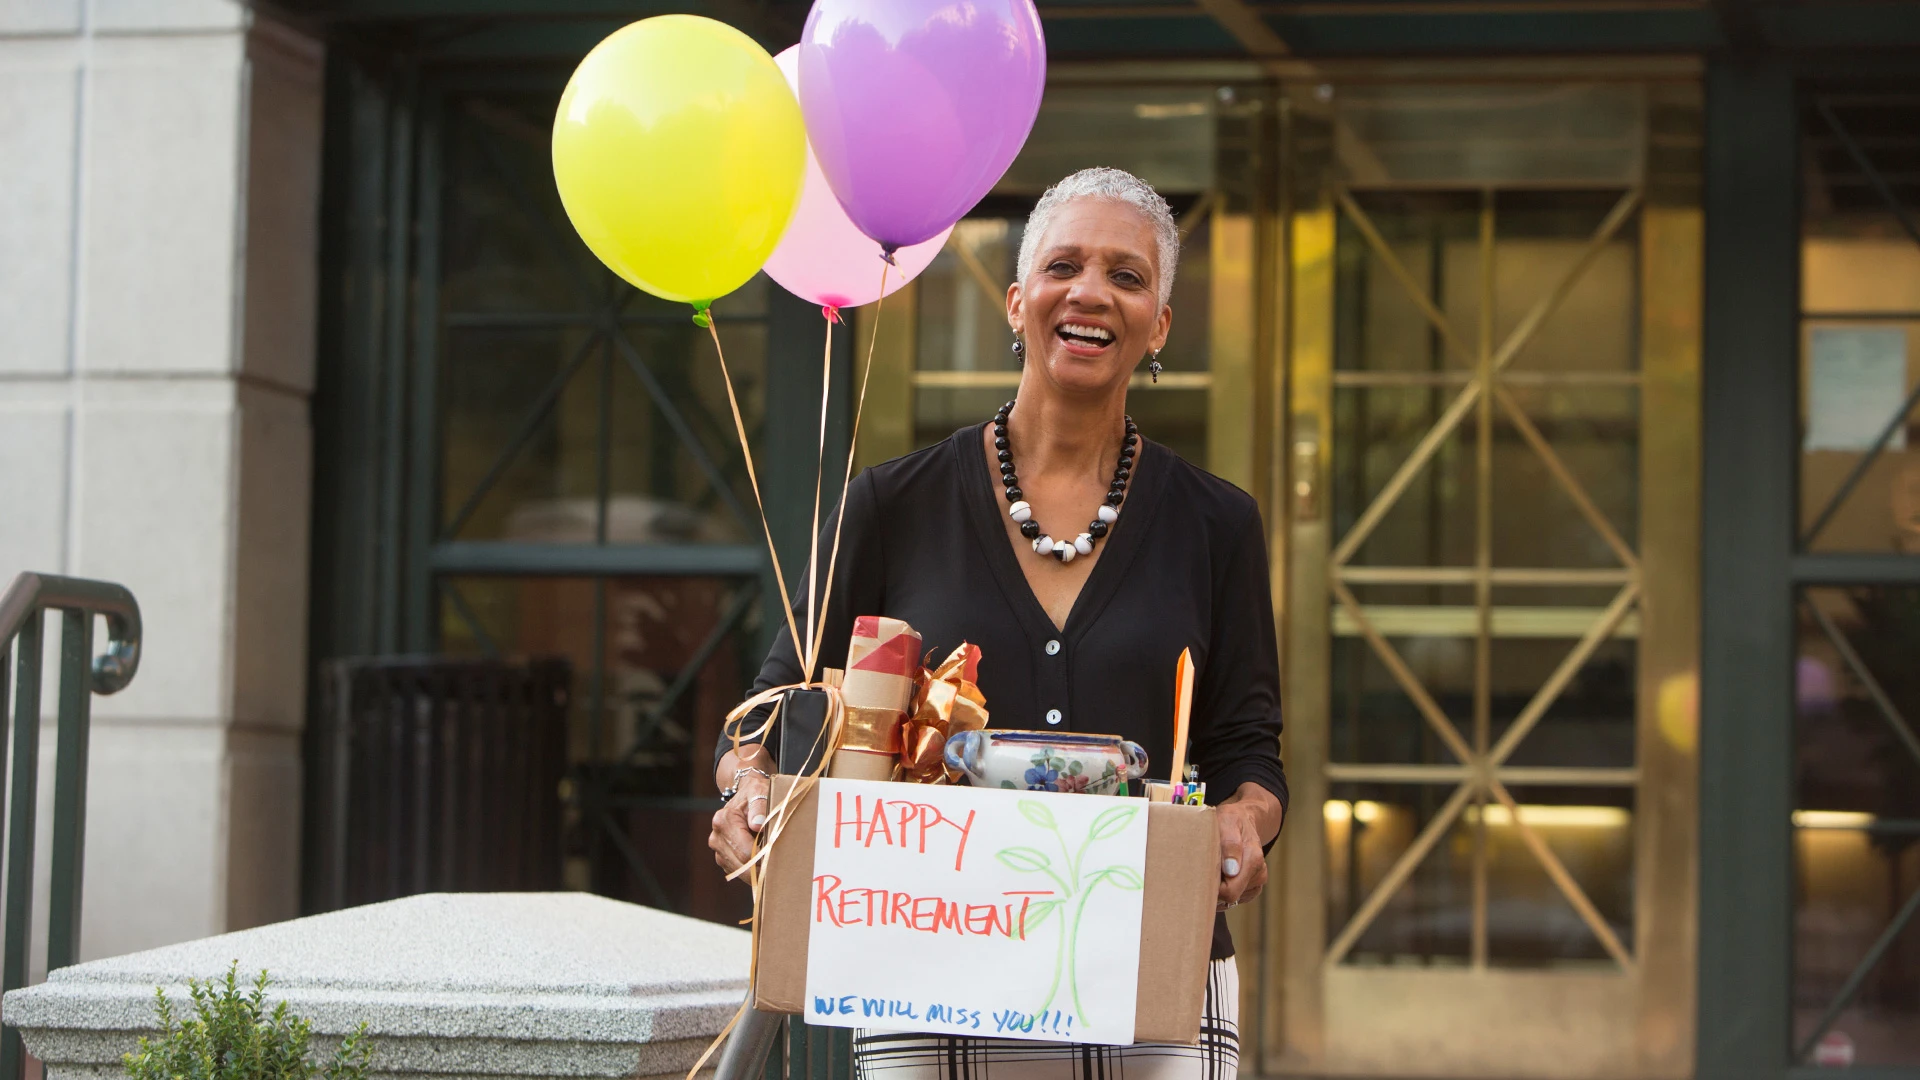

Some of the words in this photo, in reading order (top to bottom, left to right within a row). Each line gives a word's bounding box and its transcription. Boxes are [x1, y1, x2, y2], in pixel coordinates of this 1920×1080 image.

[834, 791, 976, 872] HAPPY
[812, 874, 1055, 942] RETIREMENT
[814, 995, 857, 1016] WE
[862, 998, 919, 1019] WILL
[925, 1003, 981, 1029] MISS
[993, 1009, 1073, 1036] YOU!!!
